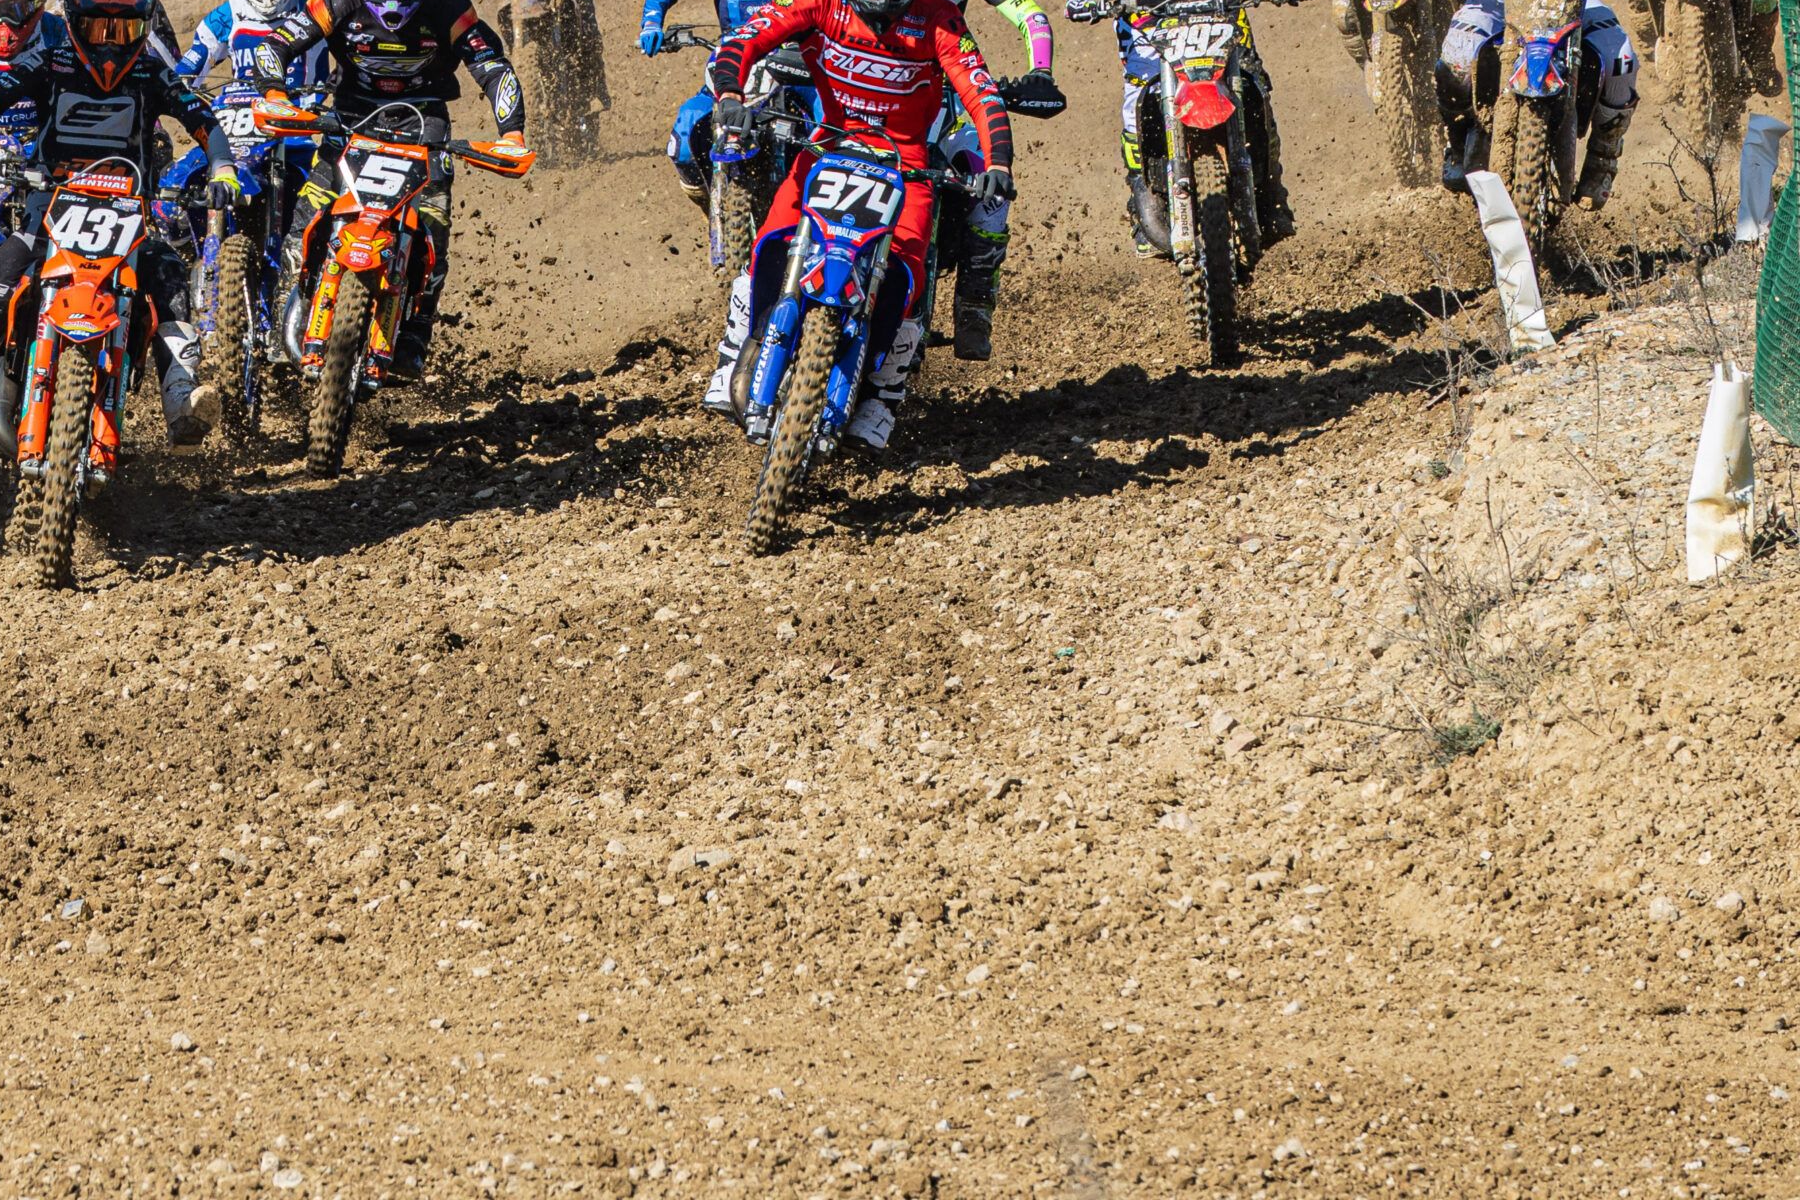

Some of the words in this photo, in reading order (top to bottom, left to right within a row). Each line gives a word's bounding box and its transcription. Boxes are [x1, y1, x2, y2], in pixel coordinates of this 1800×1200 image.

[1164, 23, 1234, 63] 392
[768, 62, 810, 78] ACERBIS
[1019, 100, 1063, 109] ACERBIS
[72, 180, 128, 191] RENTHAL
[354, 154, 413, 196] 5
[809, 170, 902, 225] 374
[51, 205, 143, 257] 431
[827, 225, 864, 242] YAMALUBE
[752, 322, 777, 396] DUNLOP
